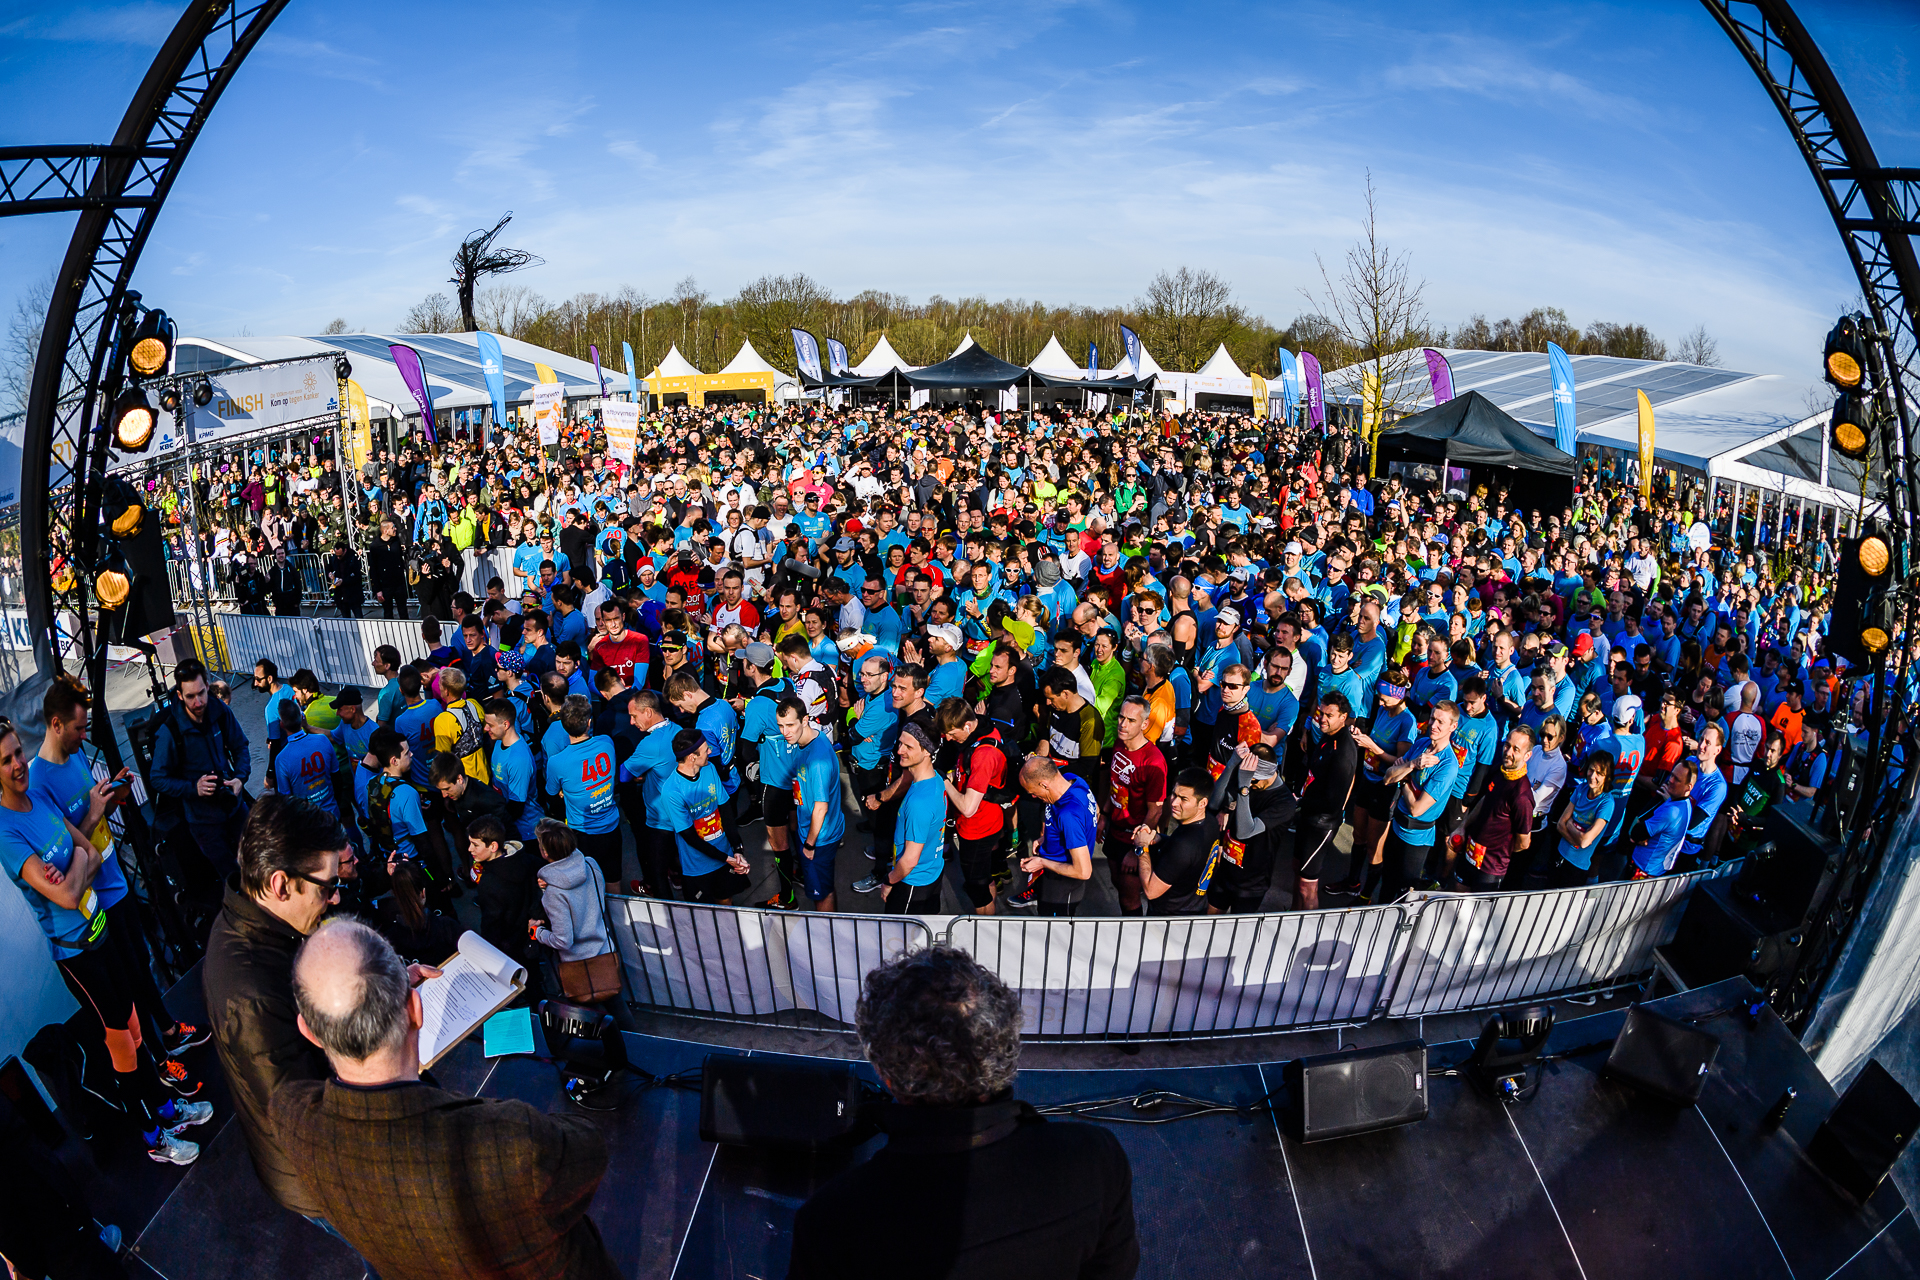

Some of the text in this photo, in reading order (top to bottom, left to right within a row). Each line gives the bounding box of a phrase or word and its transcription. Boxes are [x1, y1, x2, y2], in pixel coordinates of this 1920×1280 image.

[217, 393, 264, 419] FINISH
[270, 391, 320, 408] Kom op tegen Kanker
[1221, 405, 1251, 413] Lekker
[198, 430, 214, 440] KPMG
[159, 442, 174, 451] KBC
[606, 529, 622, 542] 40
[689, 642, 703, 663] 40
[301, 751, 326, 777] 40
[581, 752, 611, 783] 40
[1614, 749, 1640, 772] 40
[1742, 792, 1755, 807] FEET
[42, 850, 54, 863] Kom
